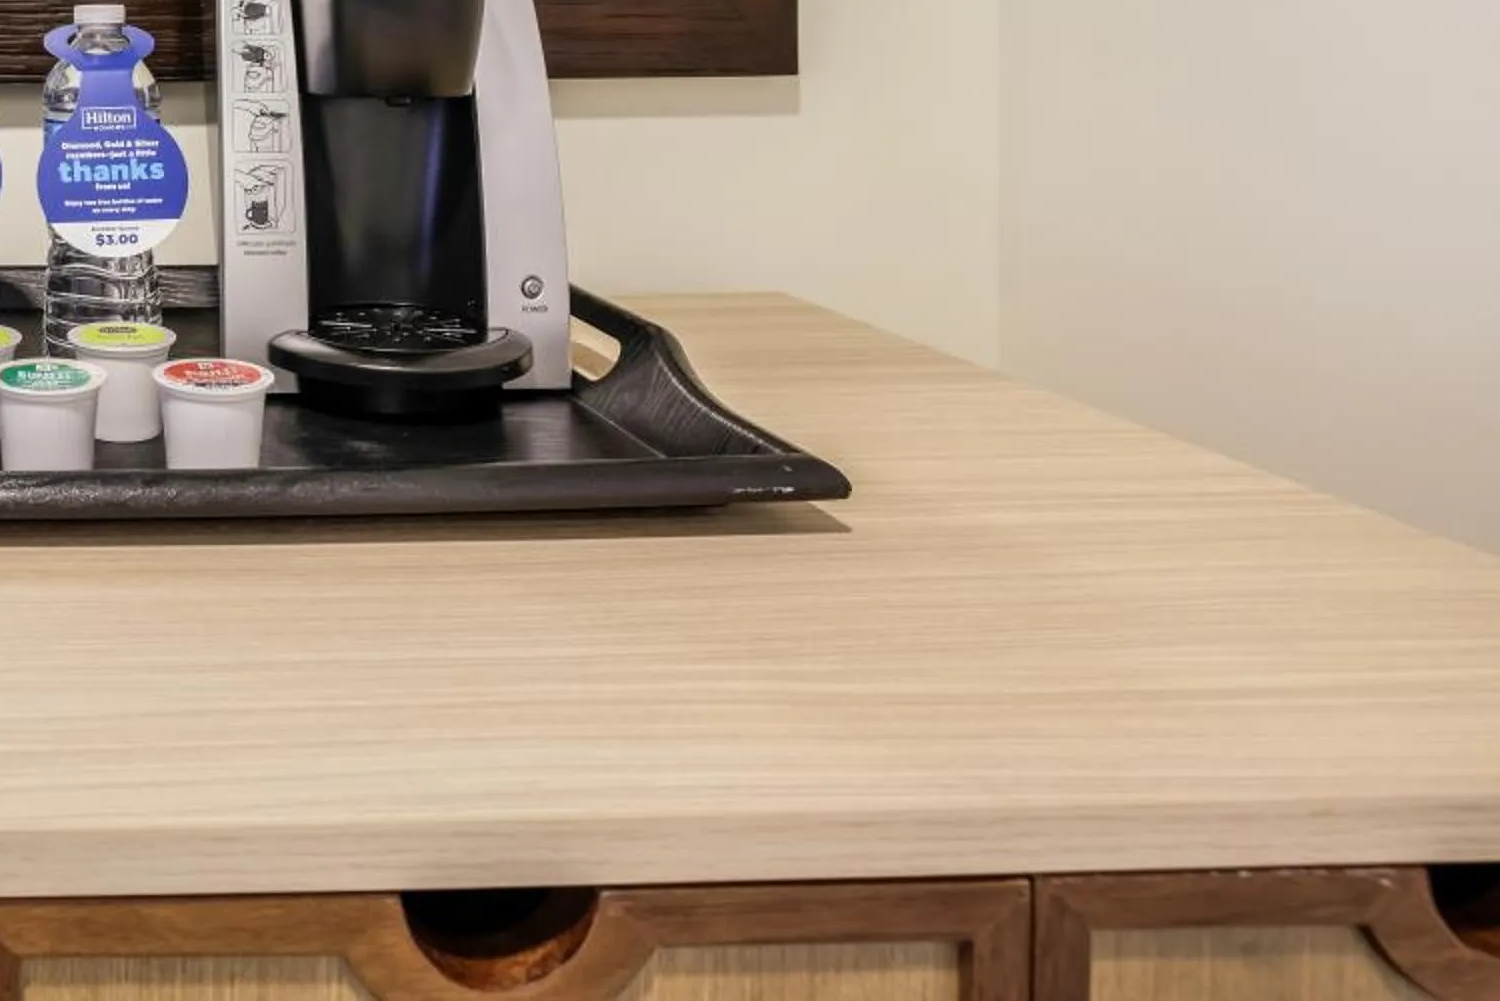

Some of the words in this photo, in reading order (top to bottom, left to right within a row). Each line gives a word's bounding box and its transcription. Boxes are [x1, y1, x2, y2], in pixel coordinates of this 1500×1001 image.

[86, 108, 132, 124] Hilton
[58, 158, 165, 183] thanks
[95, 232, 139, 247] $3.00
